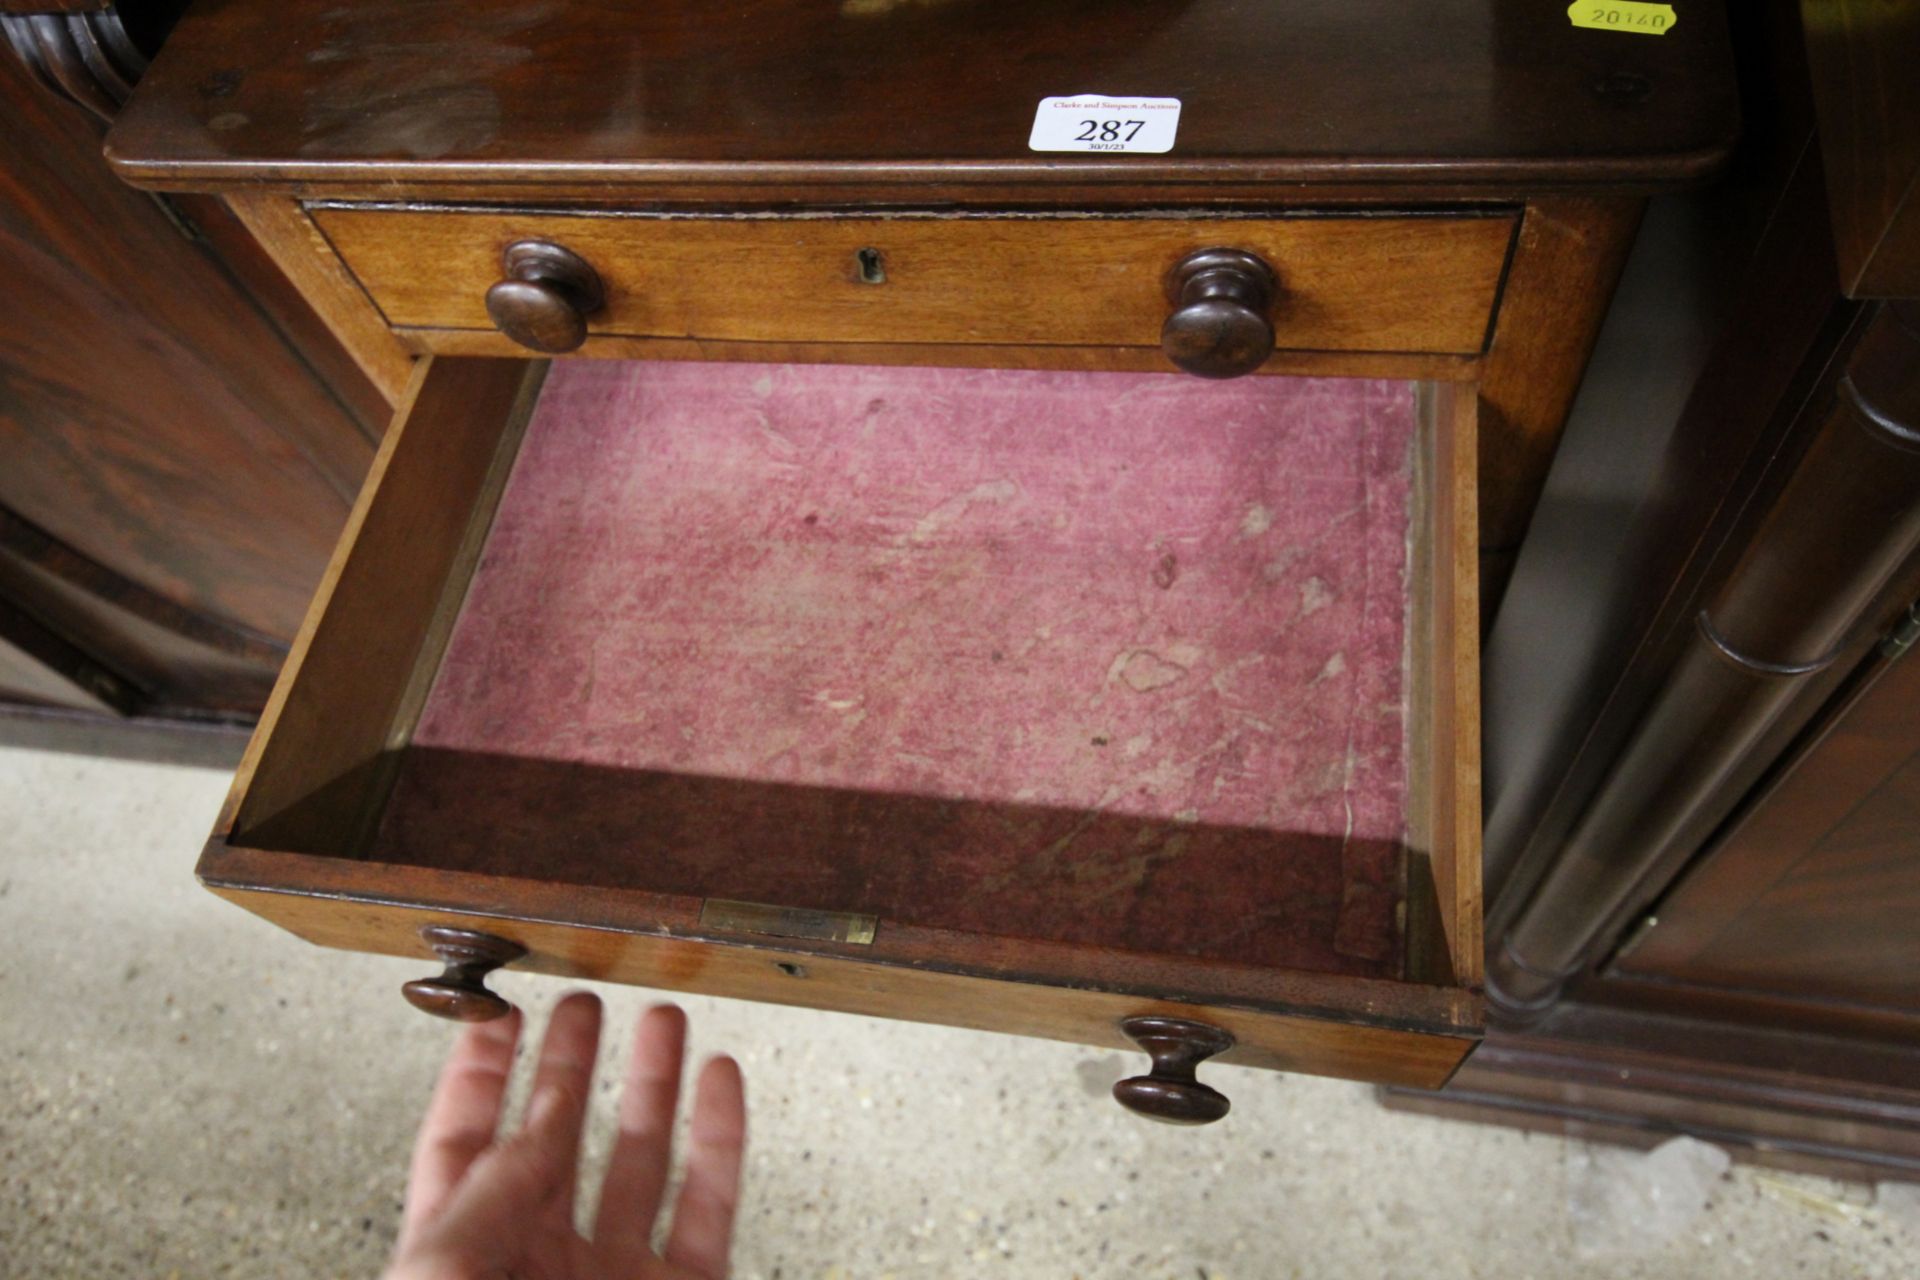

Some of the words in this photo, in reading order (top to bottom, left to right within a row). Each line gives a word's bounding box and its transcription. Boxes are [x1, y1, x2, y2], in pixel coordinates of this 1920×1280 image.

[1101, 102, 1138, 111] Simpson
[1074, 119, 1146, 142] 287
[1088, 143, 1125, 151] 30/1/23
